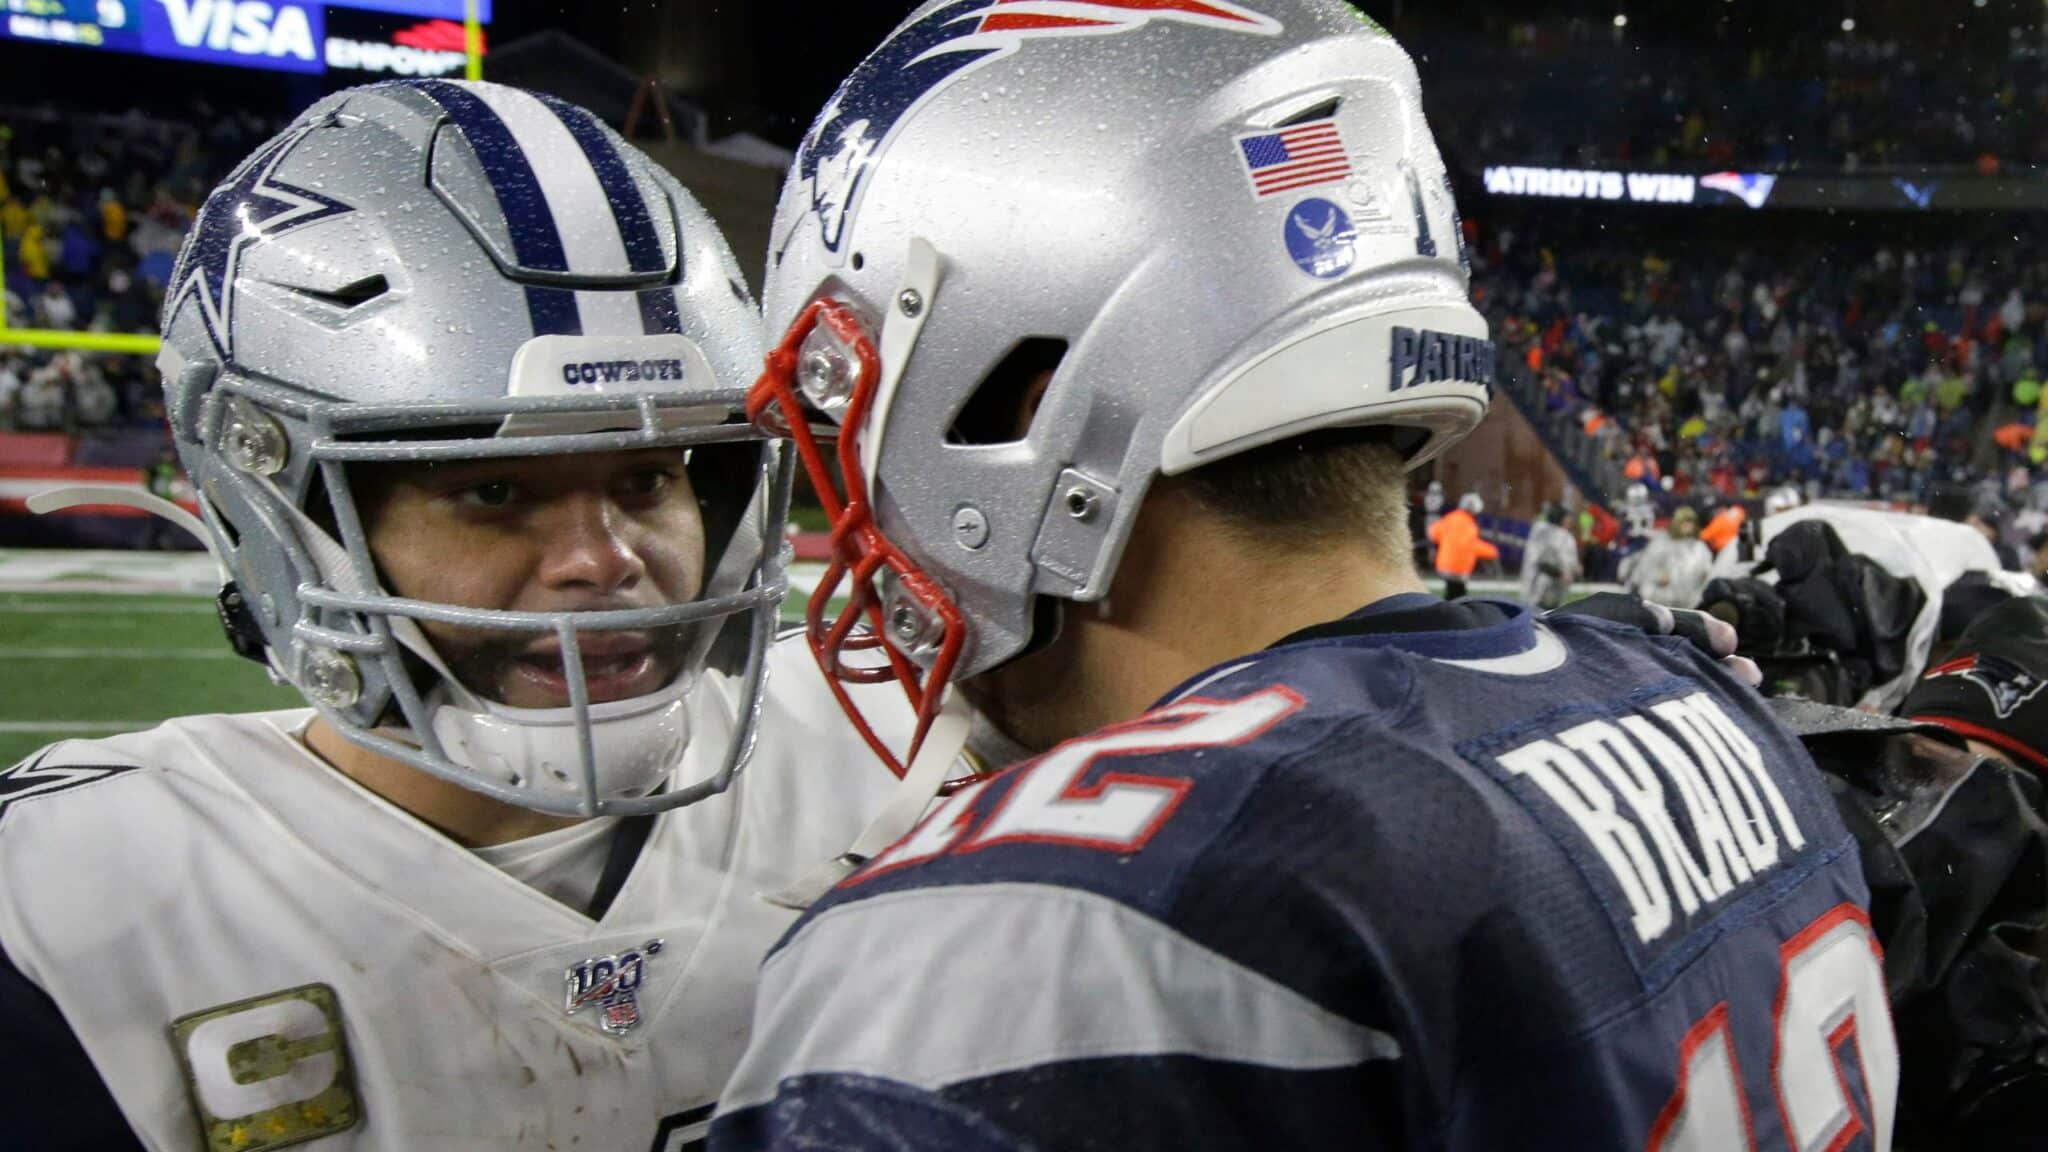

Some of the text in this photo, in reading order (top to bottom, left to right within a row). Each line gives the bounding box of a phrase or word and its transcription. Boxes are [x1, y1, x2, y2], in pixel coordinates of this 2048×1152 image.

[157, 0, 316, 60] VISA
[1627, 172, 1696, 203] WIN
[563, 358, 684, 385] COWBOYS
[1496, 690, 1805, 945] BRADY
[187, 999, 339, 1121] C
